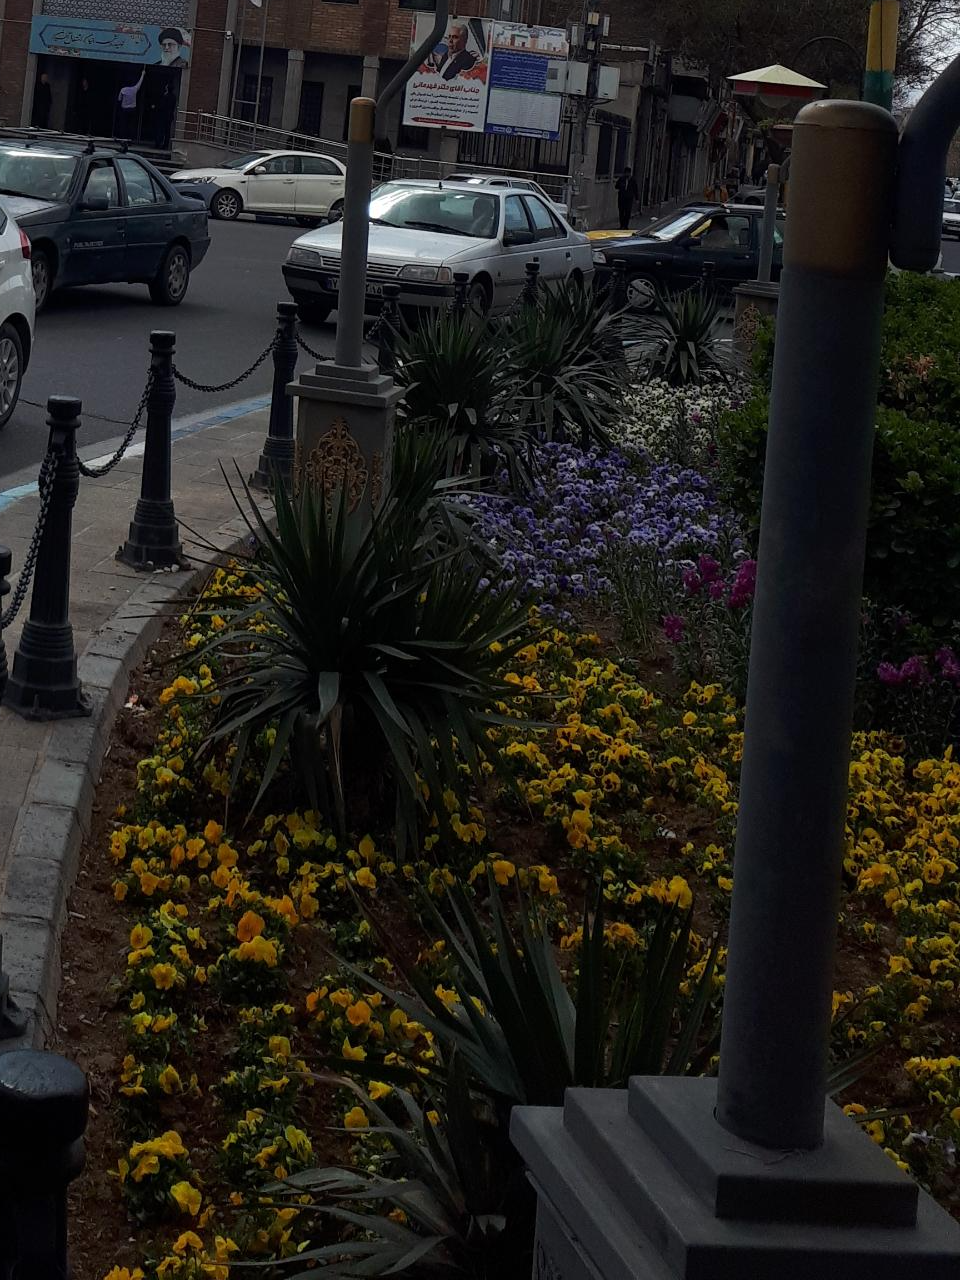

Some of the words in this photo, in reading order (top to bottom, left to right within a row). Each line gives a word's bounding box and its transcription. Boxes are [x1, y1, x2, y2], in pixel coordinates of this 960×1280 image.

[413, 81, 438, 90] قهرمانی
[437, 83, 450, 91] دکتر
[449, 84, 464, 93] آقای
[463, 86, 480, 96] جناب
